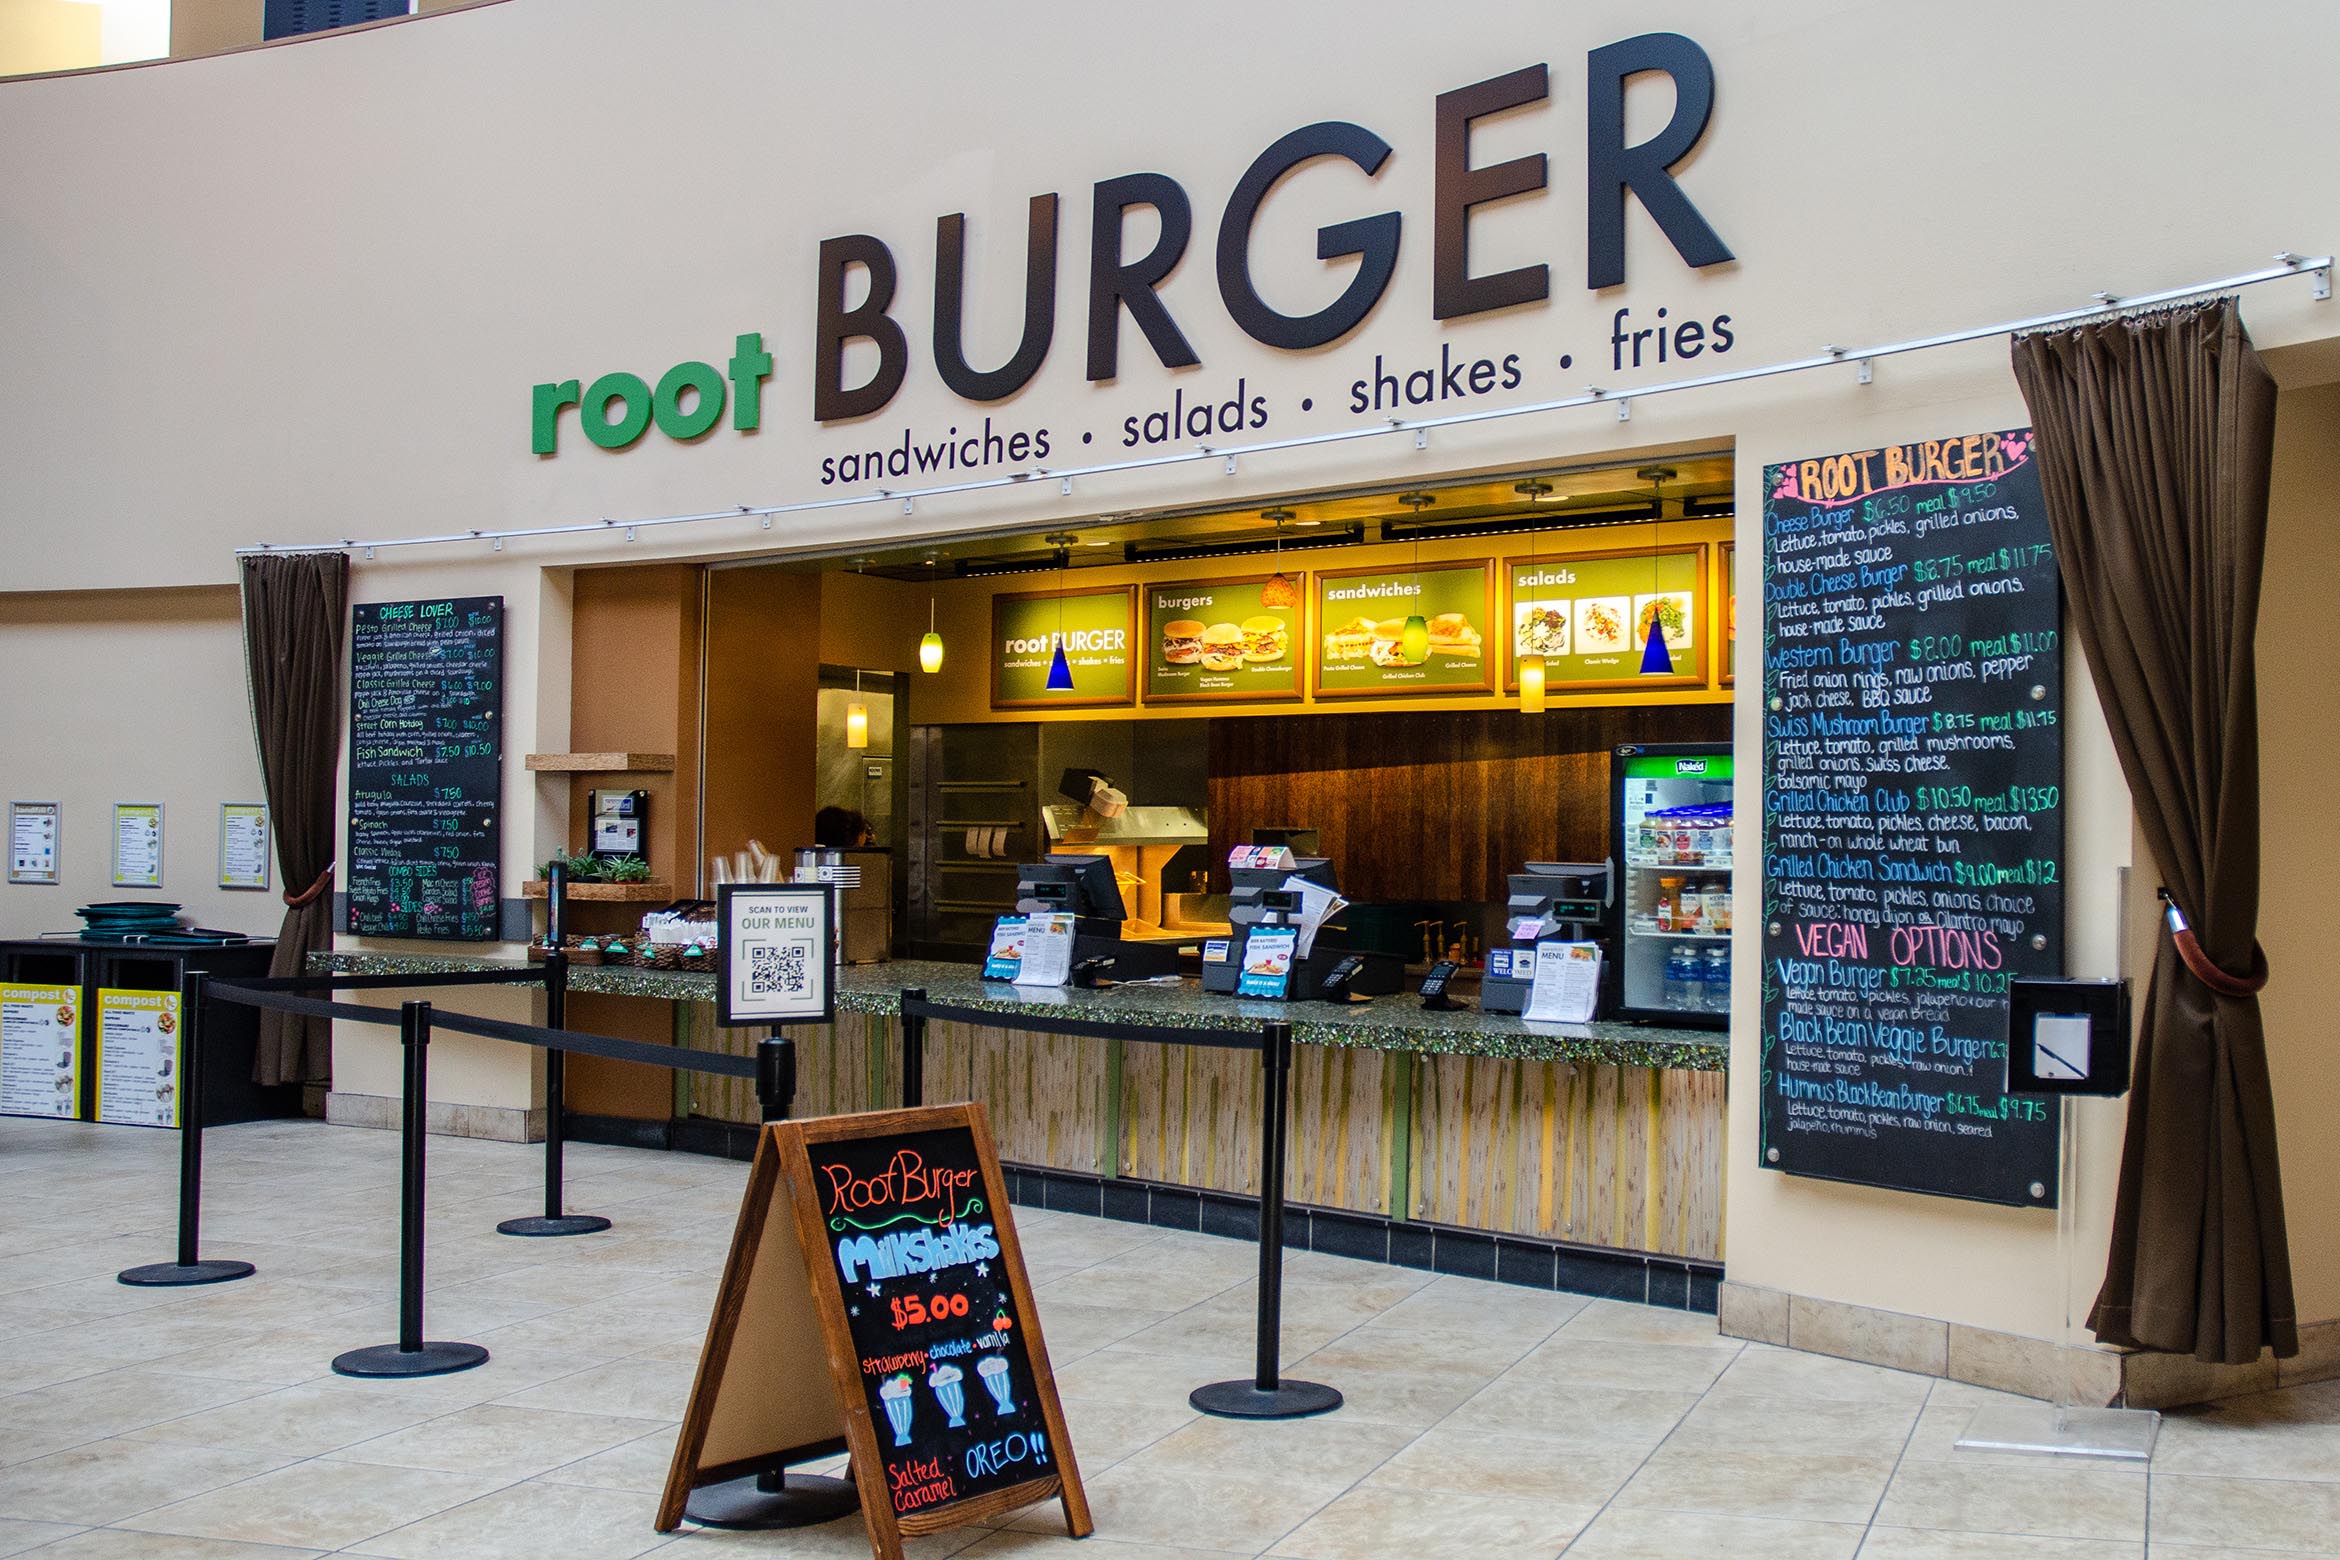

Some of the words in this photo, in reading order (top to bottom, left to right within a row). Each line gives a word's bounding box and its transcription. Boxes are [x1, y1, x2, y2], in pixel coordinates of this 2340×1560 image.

[532, 332, 773, 457] root
[813, 32, 1737, 424] BURGER
[821, 418, 1052, 486] sandwiches
[1122, 378, 1269, 447] salads
[1350, 343, 1523, 414] shakes
[1611, 307, 1736, 372] fries
[1800, 450, 1880, 500] ROOT
[1886, 433, 2005, 487] BURGER
[1766, 512, 1808, 536] Cheese
[1812, 506, 1854, 528] Burger
[1863, 494, 1911, 522] $6.50
[1917, 494, 1947, 515] meal
[1917, 514, 1958, 538] grilled
[1777, 550, 1851, 574] house-made
[1854, 546, 1893, 566] sauce
[1518, 570, 1576, 588] salads
[1766, 581, 1808, 602] Double
[1811, 574, 1858, 595] Cheese
[1861, 564, 1908, 591] Burger
[1913, 555, 1964, 582] $8.75
[1968, 553, 1997, 574] meal
[1158, 595, 1213, 610] burgers
[1328, 583, 1421, 600] sandwiches
[1919, 581, 1964, 611] grilled
[380, 605, 414, 619] CHEESE
[420, 602, 453, 618] LOVER
[1779, 616, 1845, 637] house-made
[1848, 615, 1886, 631] sauce
[1005, 635, 1048, 653] root
[1767, 646, 1834, 669] Western
[1840, 638, 1900, 674] Burger
[1911, 634, 1962, 662] $8.00
[1971, 639, 2008, 657] meal
[2010, 631, 2058, 656] $11.00
[1004, 659, 1041, 668] sandwiches
[1079, 656, 1101, 665] shakes
[1110, 656, 1125, 664] fries
[1780, 670, 1809, 688] Fried
[1814, 671, 1848, 688] onion
[1896, 666, 1923, 683] raw
[1982, 655, 2033, 682] pepper
[1785, 689, 1812, 712] jack
[1862, 688, 1890, 708] BBQ
[1894, 686, 1932, 704] sauce
[1768, 715, 1808, 737] Swiss
[1812, 712, 1880, 736] Mushroom
[1882, 709, 1931, 740] Burger
[1932, 710, 1975, 732] $8.75
[1980, 713, 2014, 731] meal
[2016, 710, 2057, 730] $11.75
[356, 748, 376, 760] Fish
[379, 746, 423, 757] Sandwich
[1879, 736, 1919, 760] grilled
[391, 774, 430, 786] SALADS
[1679, 762, 1704, 771] Naked
[1777, 774, 1832, 790] balsamic
[1836, 773, 1867, 794] mayo
[1767, 790, 1814, 813] Grilled
[1816, 788, 1870, 813] Chicken
[1875, 790, 1910, 813] Club
[1916, 786, 1972, 811] $10.50
[1975, 796, 2009, 813] meal
[1848, 834, 1885, 850] whole
[1890, 833, 1928, 852] wheat
[1936, 837, 1960, 853] bun
[1768, 854, 1814, 878] Grilled
[1817, 853, 1874, 881] Chicken
[1878, 854, 1953, 883] Sandwich
[1955, 860, 1998, 887] $9.00
[1998, 866, 2024, 885] meal
[2026, 860, 2059, 886] $12
[742, 918, 770, 929] OUR
[774, 917, 815, 928] MENU
[749, 906, 772, 914] SCAN
[1542, 952, 1564, 960] MENU
[1796, 923, 1867, 960] VEGAN
[1891, 926, 2002, 970] OPTIONS
[1777, 957, 1825, 991] Vegan
[1829, 960, 1888, 999] Burger
[1, 988, 60, 1004] compost
[104, 996, 161, 1008] compost
[1779, 1012, 1823, 1042] Black
[1826, 1017, 1868, 1047] Bean
[1869, 1023, 1927, 1064] Veggie
[1932, 1026, 1991, 1065] Burger
[1777, 1072, 1835, 1099] Hummus
[821, 1156, 898, 1215] Root
[897, 1150, 978, 1228] Burger
[890, 1294, 969, 1331] $5.00
[862, 1351, 927, 1375] strawberry
[929, 1340, 972, 1360] chocolate
[976, 1330, 1010, 1350] vanilla
[889, 1457, 944, 1489] Salted
[894, 1476, 957, 1511] Caramel
